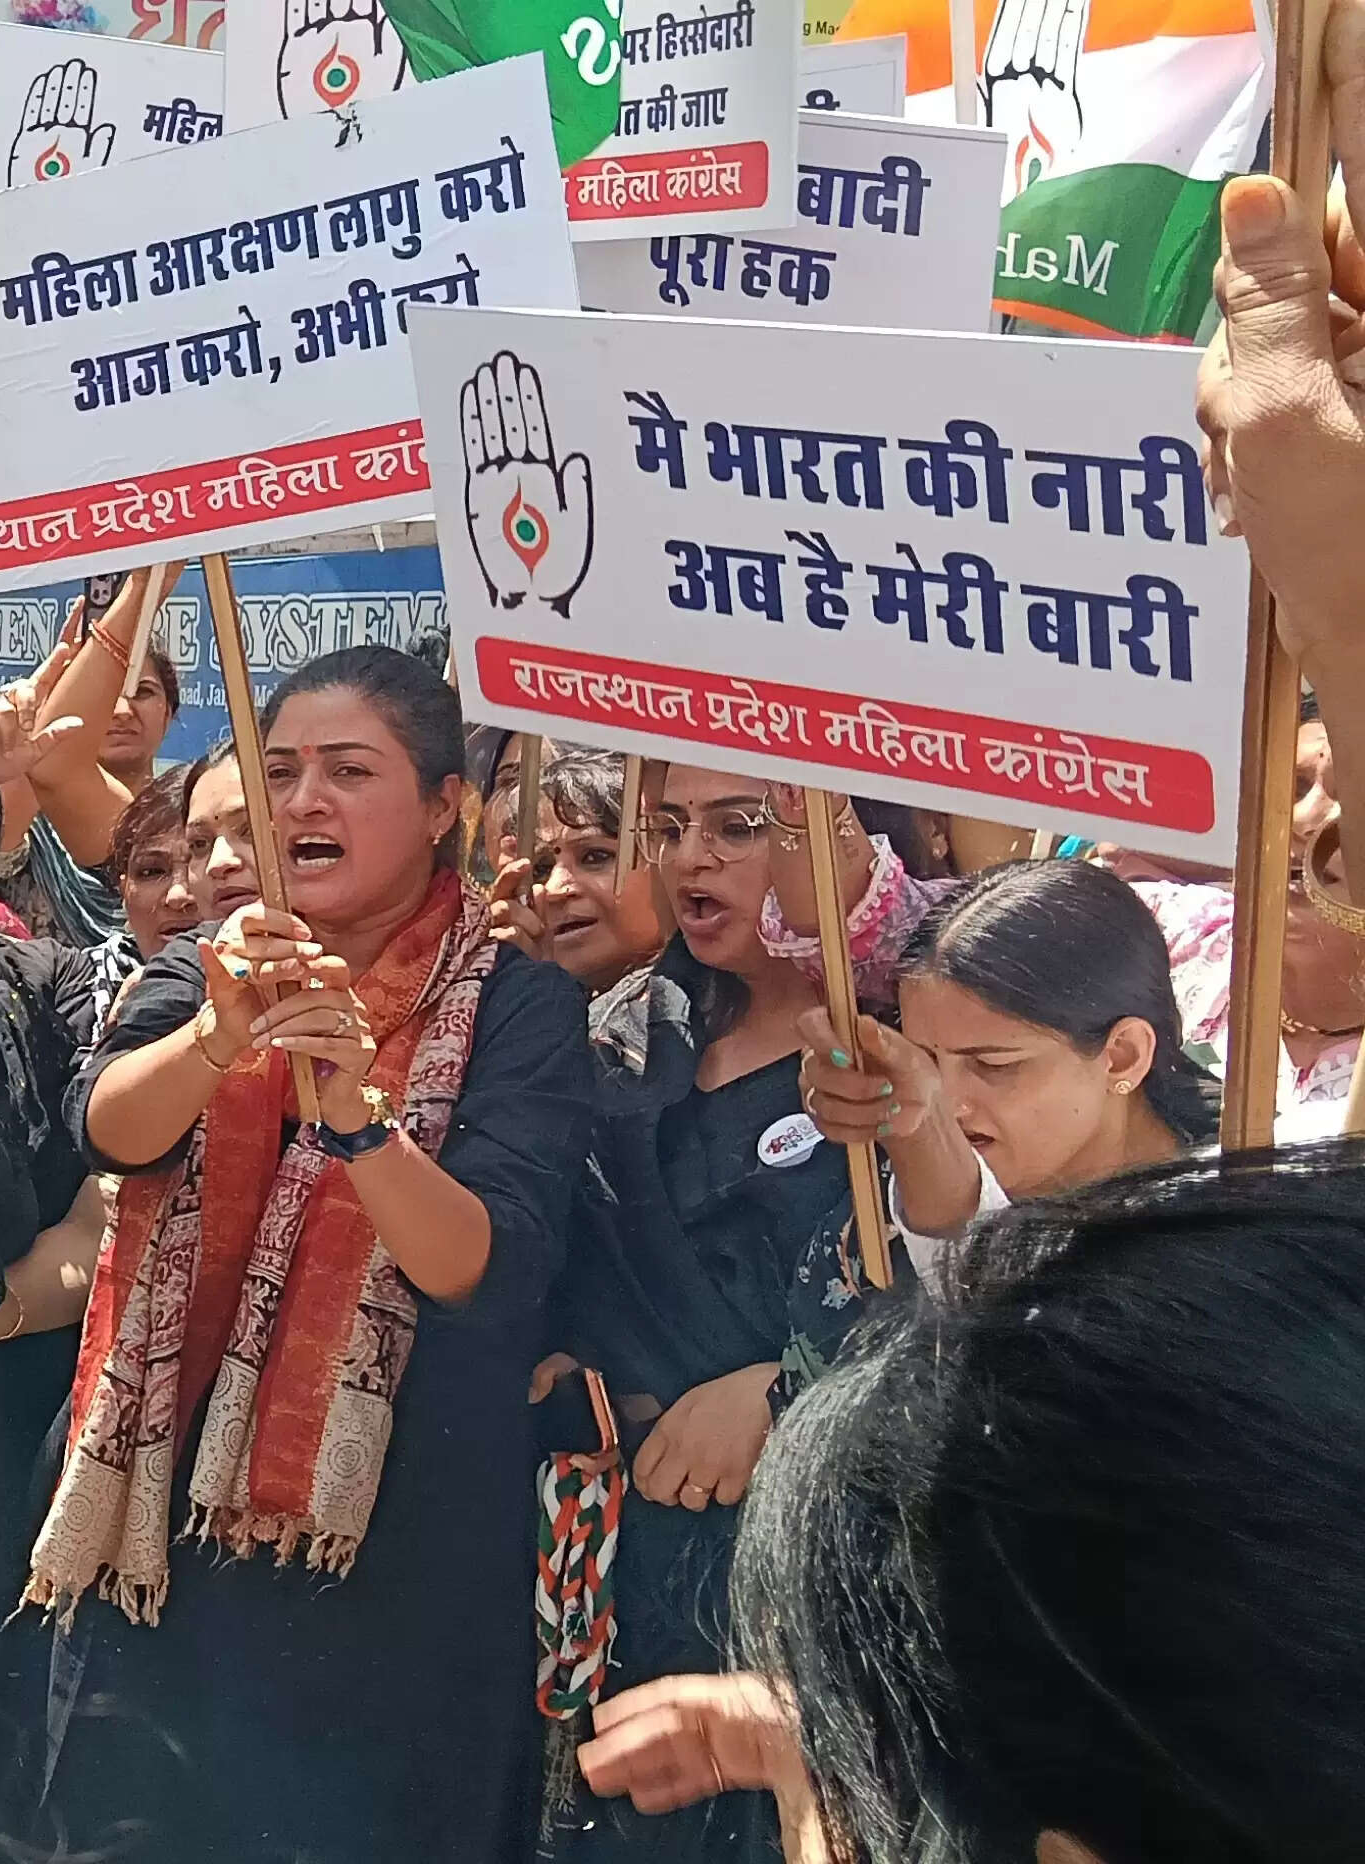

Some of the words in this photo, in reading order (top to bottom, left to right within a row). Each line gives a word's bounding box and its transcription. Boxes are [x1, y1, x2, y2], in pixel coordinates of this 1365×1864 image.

[622, 26, 651, 66] पर
[143, 97, 223, 144] महिल
[646, 84, 677, 132] की
[680, 87, 729, 129] जाए
[146, 204, 320, 296] आरक्षण
[324, 178, 423, 259] लागु
[435, 136, 525, 223] करो
[577, 158, 663, 210] महिला
[665, 150, 744, 198] कांग्रेस
[798, 155, 932, 238] बादी
[741, 239, 837, 306] हक
[71, 340, 170, 412] आज
[291, 278, 387, 364] अभी
[89, 483, 193, 537] प्रदेश
[206, 455, 344, 511] महिला
[623, 390, 688, 491] मै
[704, 421, 888, 511] भारत
[898, 418, 1014, 525] की
[1024, 434, 1209, 547] नारी
[209, 591, 447, 675] YSTEM
[664, 539, 785, 623] अब
[784, 530, 853, 632] है
[865, 542, 1009, 656] मेरी
[1020, 573, 1200, 683] बारी
[509, 657, 698, 728] राजस्थान
[703, 679, 812, 747] प्रदेश
[819, 701, 972, 773] महिला
[979, 731, 1154, 807] कांग्रेस
